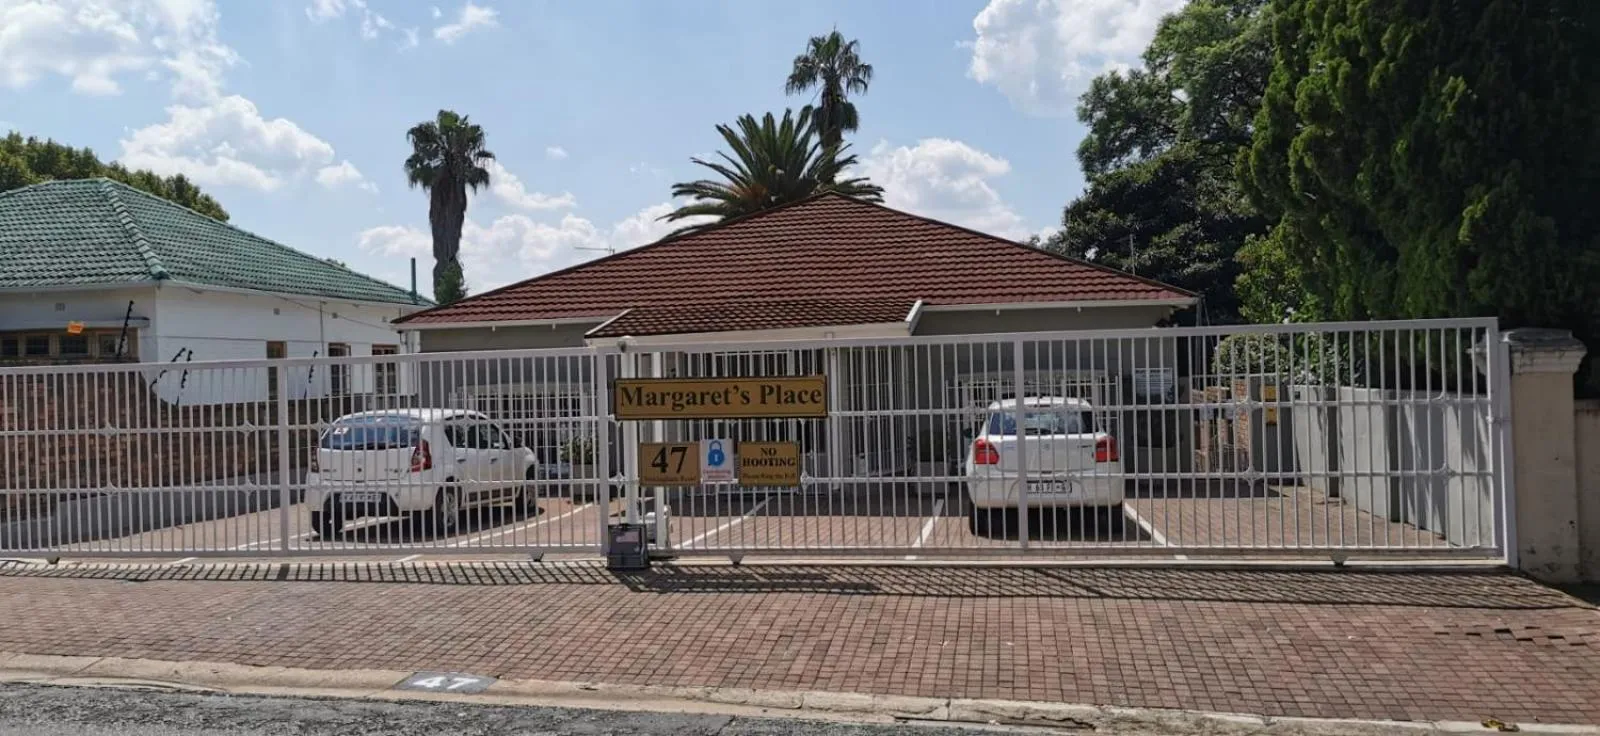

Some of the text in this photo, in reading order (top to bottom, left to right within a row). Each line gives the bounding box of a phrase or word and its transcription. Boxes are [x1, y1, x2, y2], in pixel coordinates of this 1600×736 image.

[620, 384, 822, 411] Margaret's Place
[760, 447, 777, 457] NO
[652, 446, 688, 474] 47
[743, 457, 796, 467] HOOTING
[413, 676, 480, 690] 47
